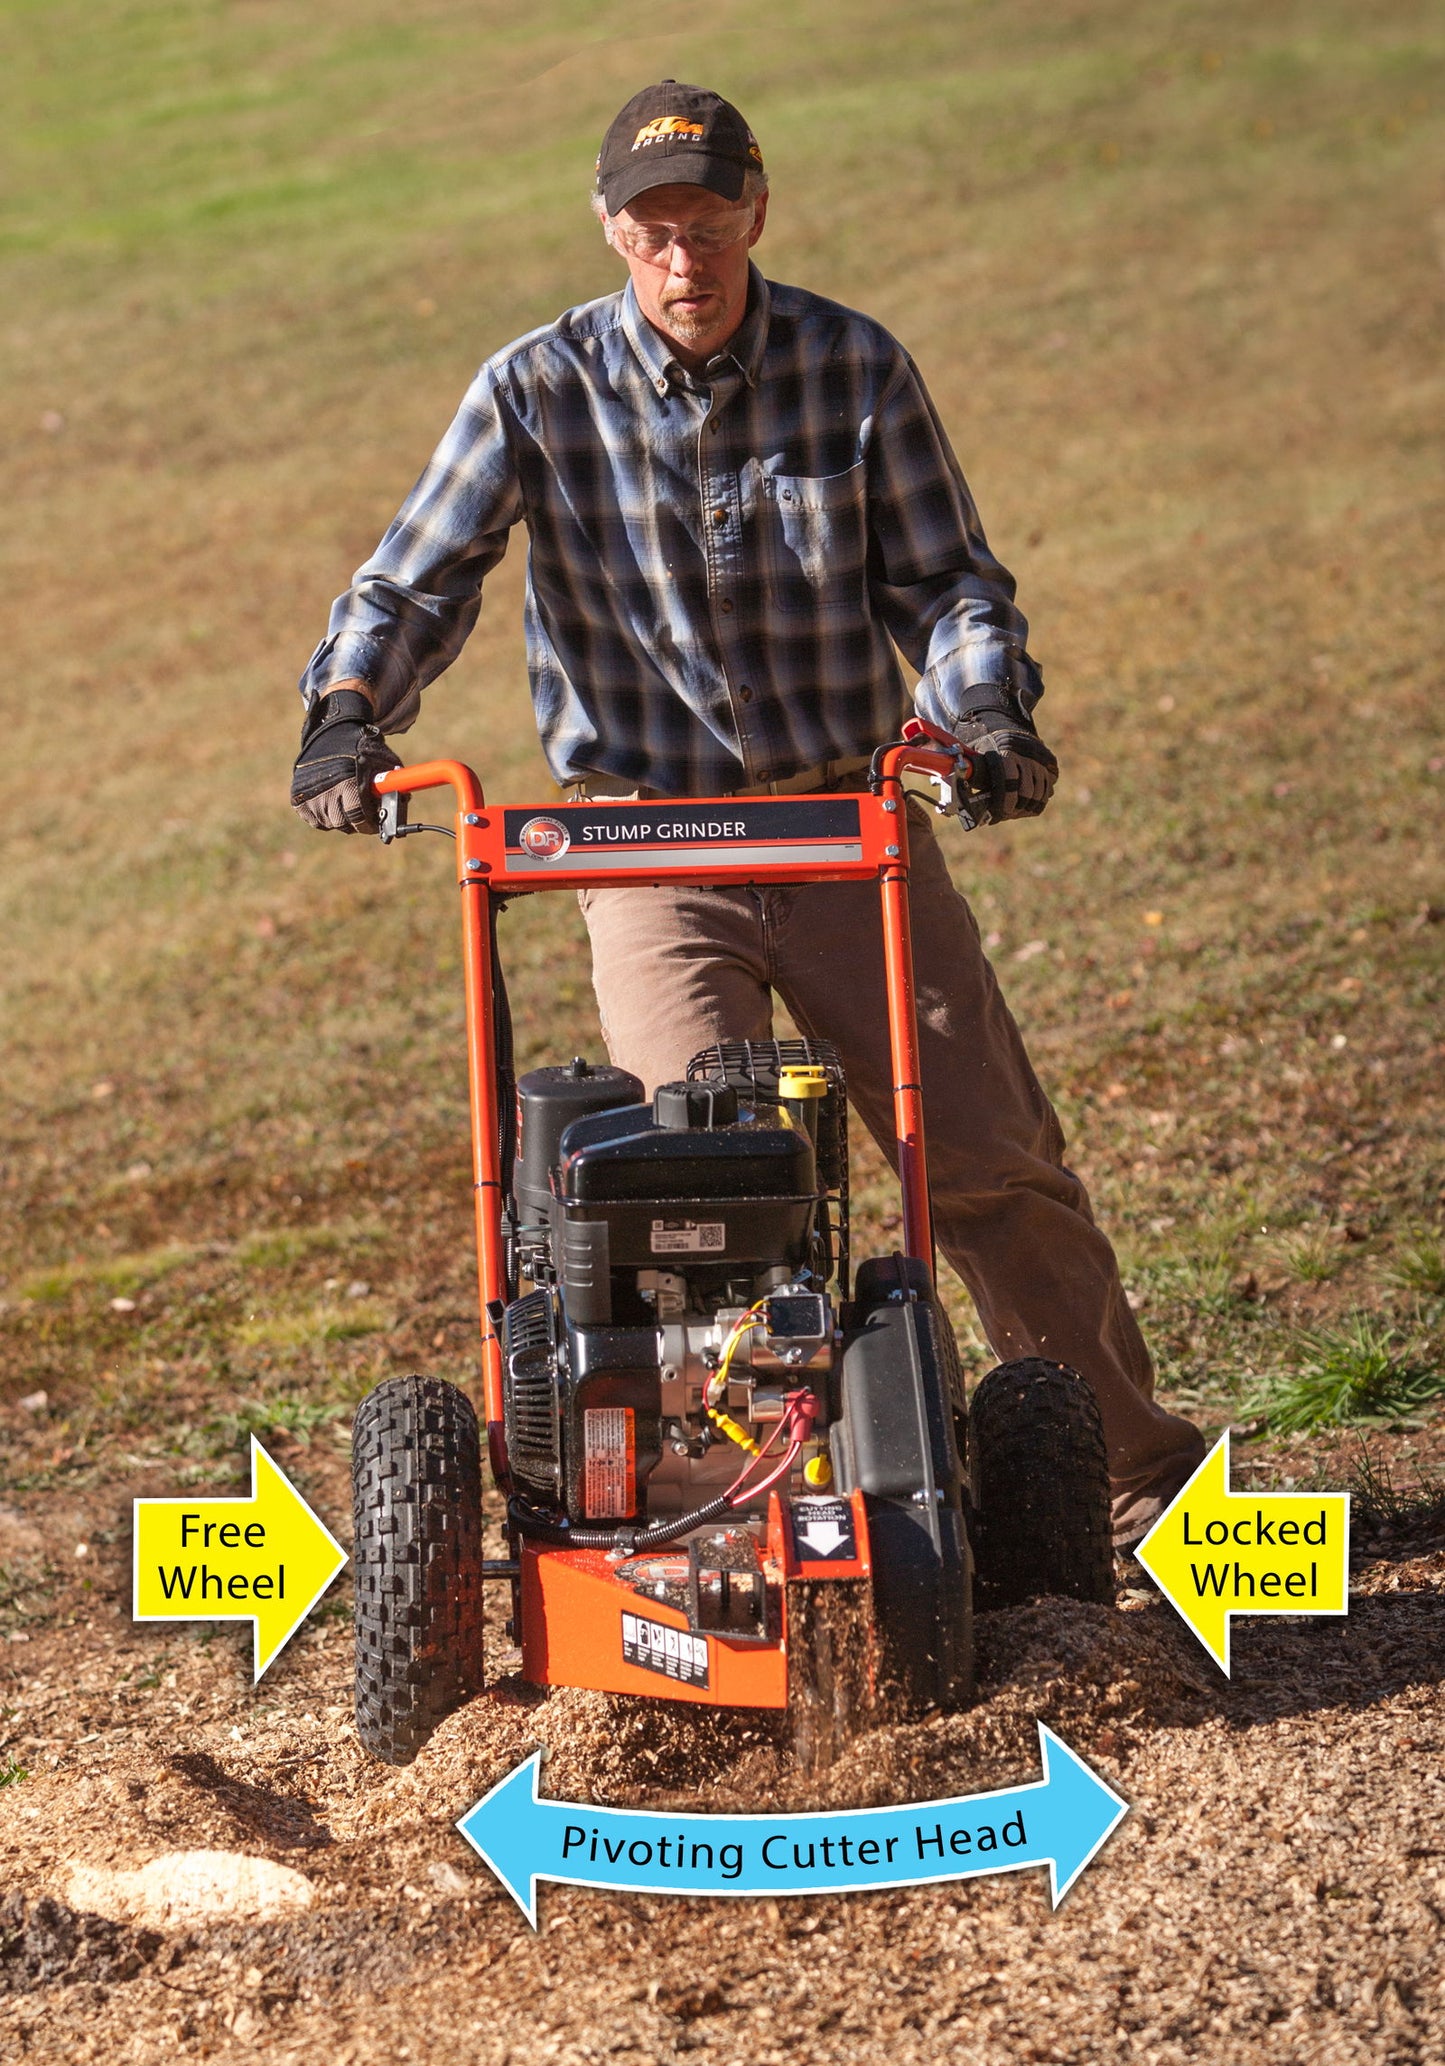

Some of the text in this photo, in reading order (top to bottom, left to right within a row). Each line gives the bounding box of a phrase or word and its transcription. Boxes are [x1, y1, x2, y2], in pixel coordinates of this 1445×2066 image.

[631, 132, 701, 153] RACING
[530, 831, 559, 847] DR
[583, 822, 747, 841] STUMP GRINDER
